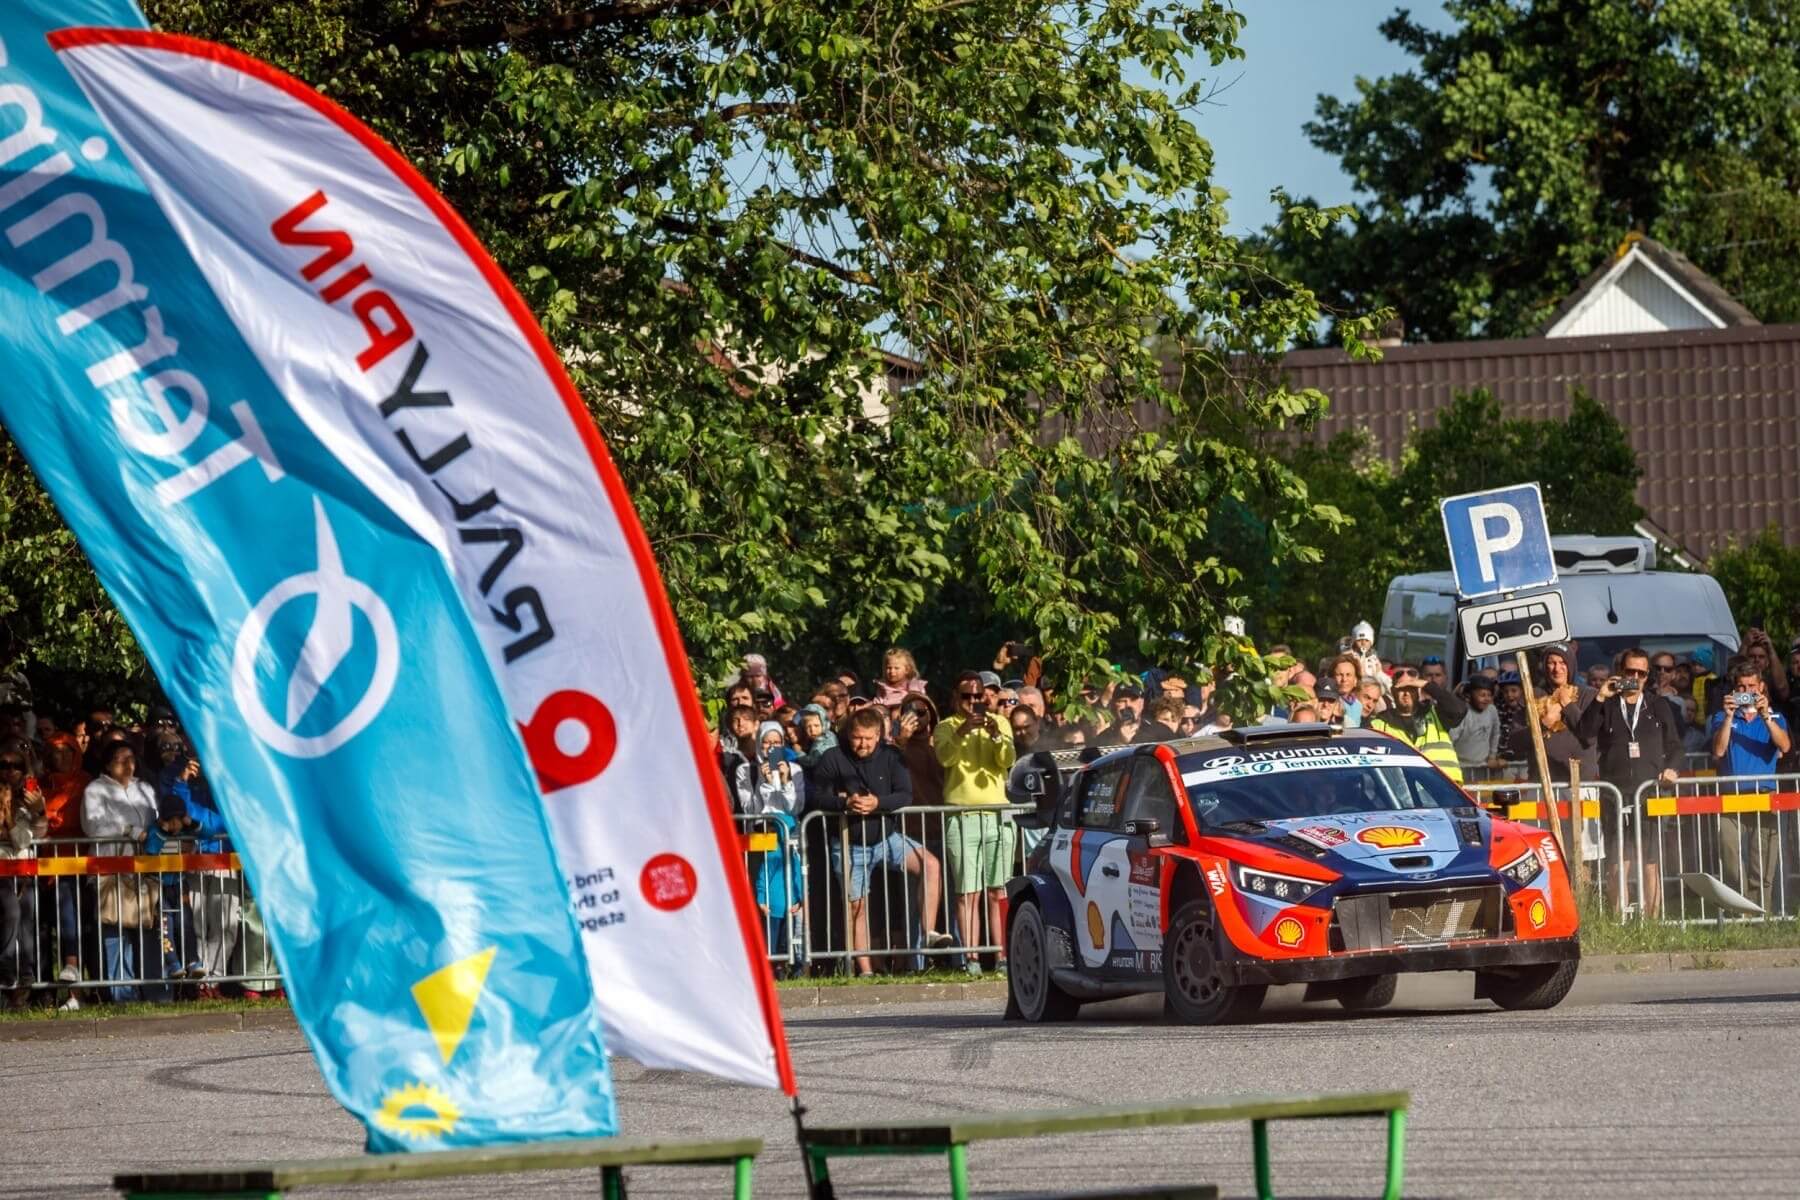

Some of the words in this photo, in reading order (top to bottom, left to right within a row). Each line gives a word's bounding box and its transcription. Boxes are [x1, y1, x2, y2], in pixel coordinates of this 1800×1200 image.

[1468, 502, 1524, 583] P
[1249, 747, 1348, 762] HYUNDAI
[1283, 757, 1353, 769] Terminal
